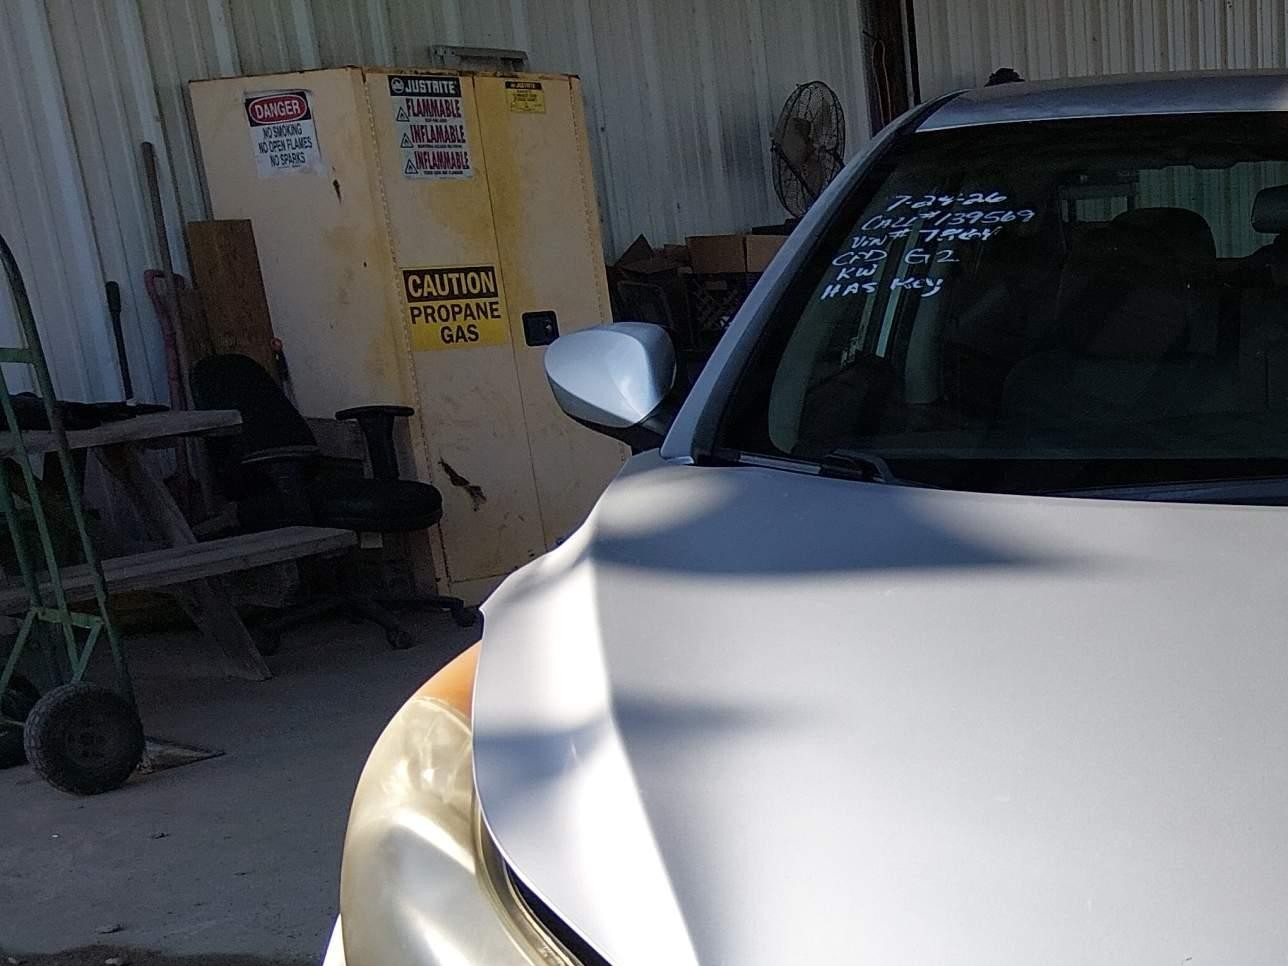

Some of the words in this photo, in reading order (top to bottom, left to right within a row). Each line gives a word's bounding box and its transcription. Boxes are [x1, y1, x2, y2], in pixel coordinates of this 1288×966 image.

[405, 79, 456, 94] JUSTRITE
[254, 100, 301, 119] DANGER
[405, 98, 462, 118] FLAMMABLE
[262, 126, 273, 138] NO
[272, 123, 303, 138] SMOKING
[410, 124, 466, 144] INFLAMABLE
[258, 142, 269, 154] NO
[269, 139, 286, 153] OPEN
[286, 136, 313, 150] FLAMES
[270, 154, 280, 167] NO
[280, 151, 306, 166] SPARKS
[413, 151, 470, 170] INFLAMMABLE
[408, 272, 496, 298] CAUTION
[820, 282, 878, 300] HAS
[410, 301, 501, 325] PROPANE
[440, 323, 480, 344] GAS
